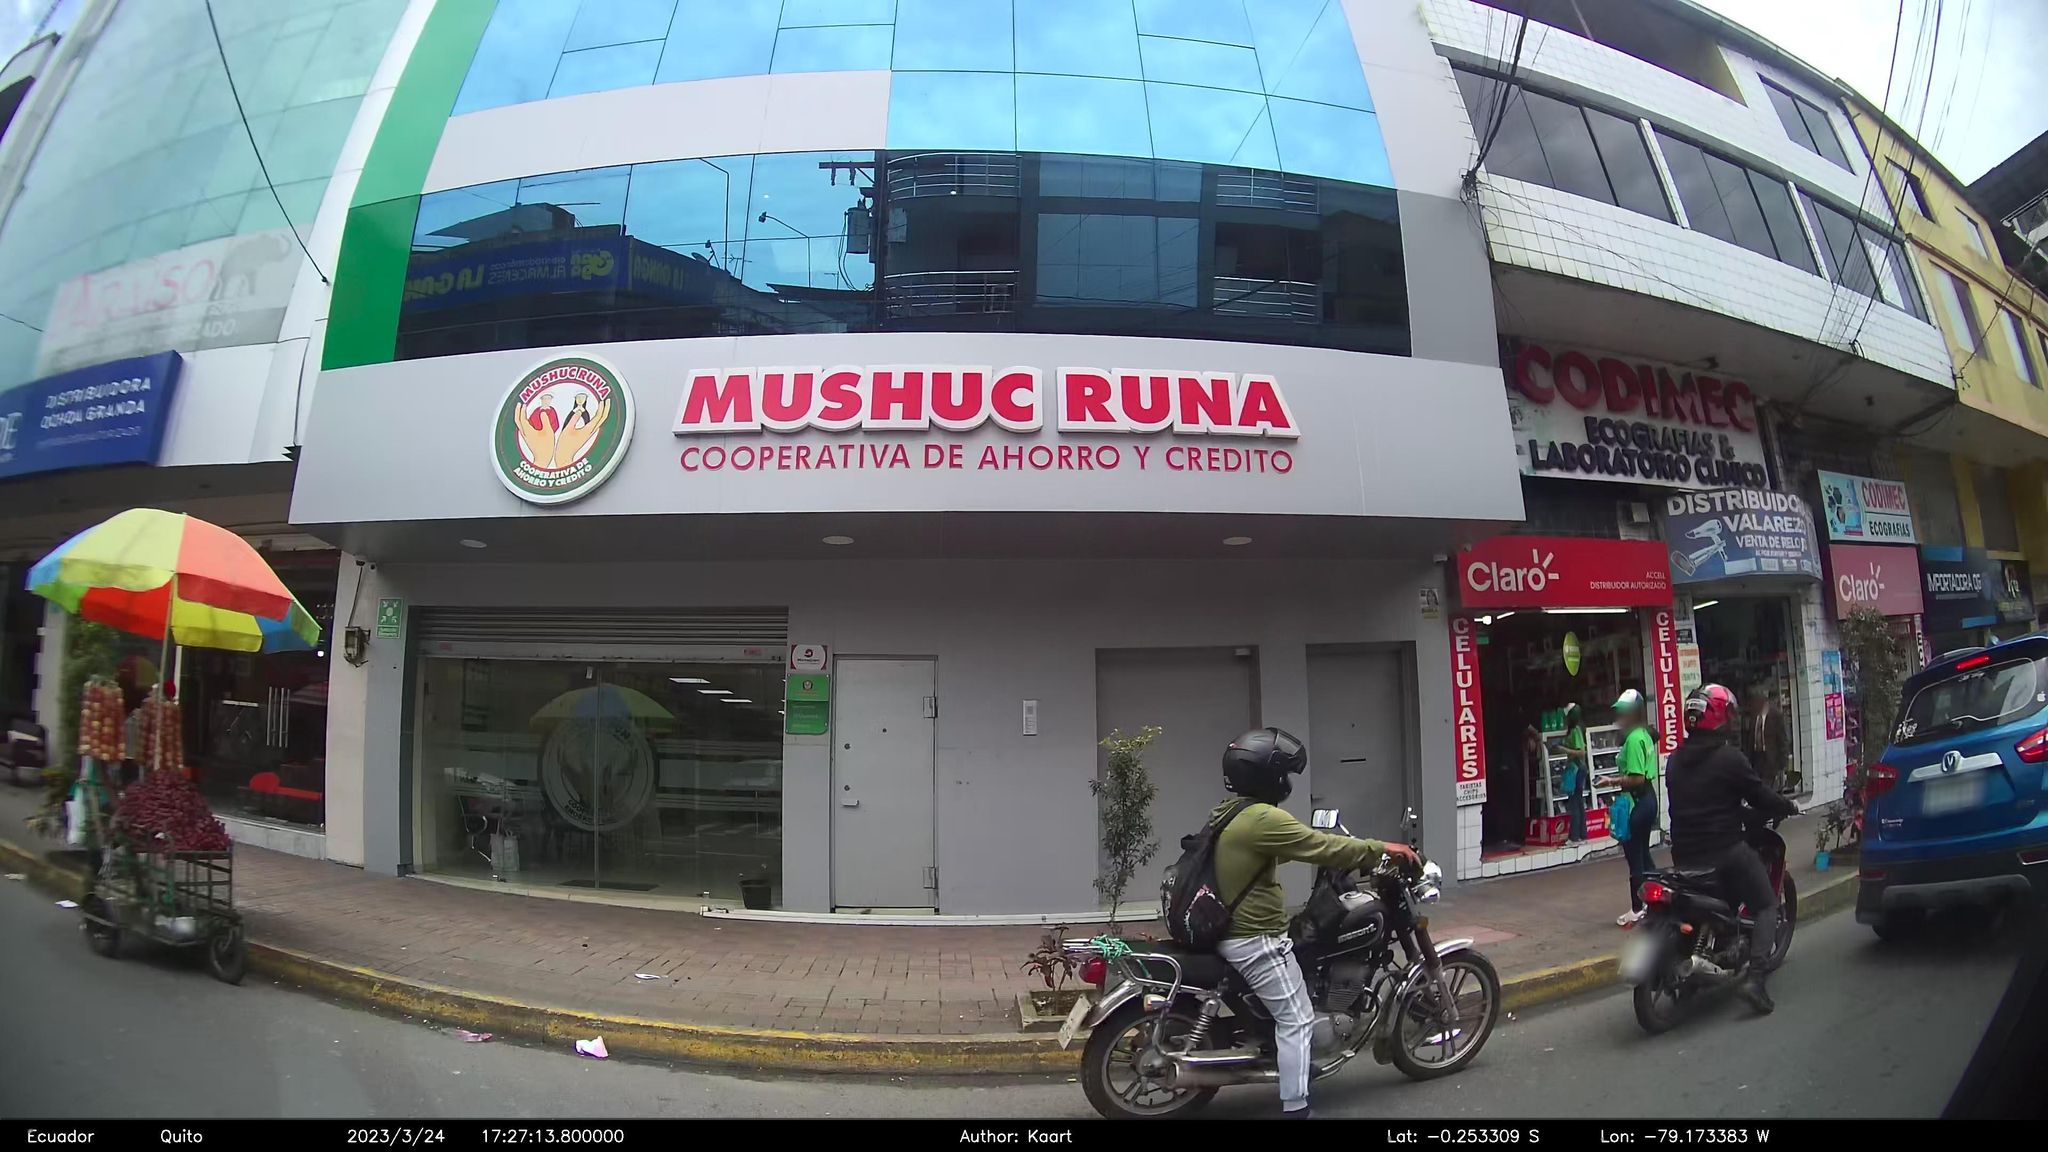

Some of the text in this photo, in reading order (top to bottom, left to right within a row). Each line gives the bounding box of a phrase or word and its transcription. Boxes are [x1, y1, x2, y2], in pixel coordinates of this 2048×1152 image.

[45, 377, 151, 408] DISTRIBUIDORA
[519, 367, 610, 402] MUSHUC RUNA
[1516, 345, 1757, 432] CODIMEC
[681, 371, 1291, 429] MUSHUC RUNA
[1583, 415, 1736, 460] ECOGRAFIAS &
[520, 457, 589, 479] COOPERATIVA DE
[680, 444, 1293, 474] COOPERATIVA DE AHORRO Y CREDITO
[1528, 438, 1768, 488] LABORATORIO CLINICO
[513, 467, 547, 487] AHORRO
[554, 464, 592, 486] CREDITO
[1860, 481, 1907, 510] CODIMEC
[1736, 534, 1768, 548] VENTA
[1769, 536, 1781, 548] DE
[1868, 520, 1911, 538] ECOGRAFIAS
[1467, 560, 1546, 592] Claro
[1590, 581, 1667, 590] DISTRIBUIDOR AUTORIZADO
[1839, 574, 1879, 602] Claro
[1926, 573, 1973, 592] IMPORTADORA
[1655, 611, 1679, 751] CELULARES
[1451, 616, 1479, 779] CELULARES
